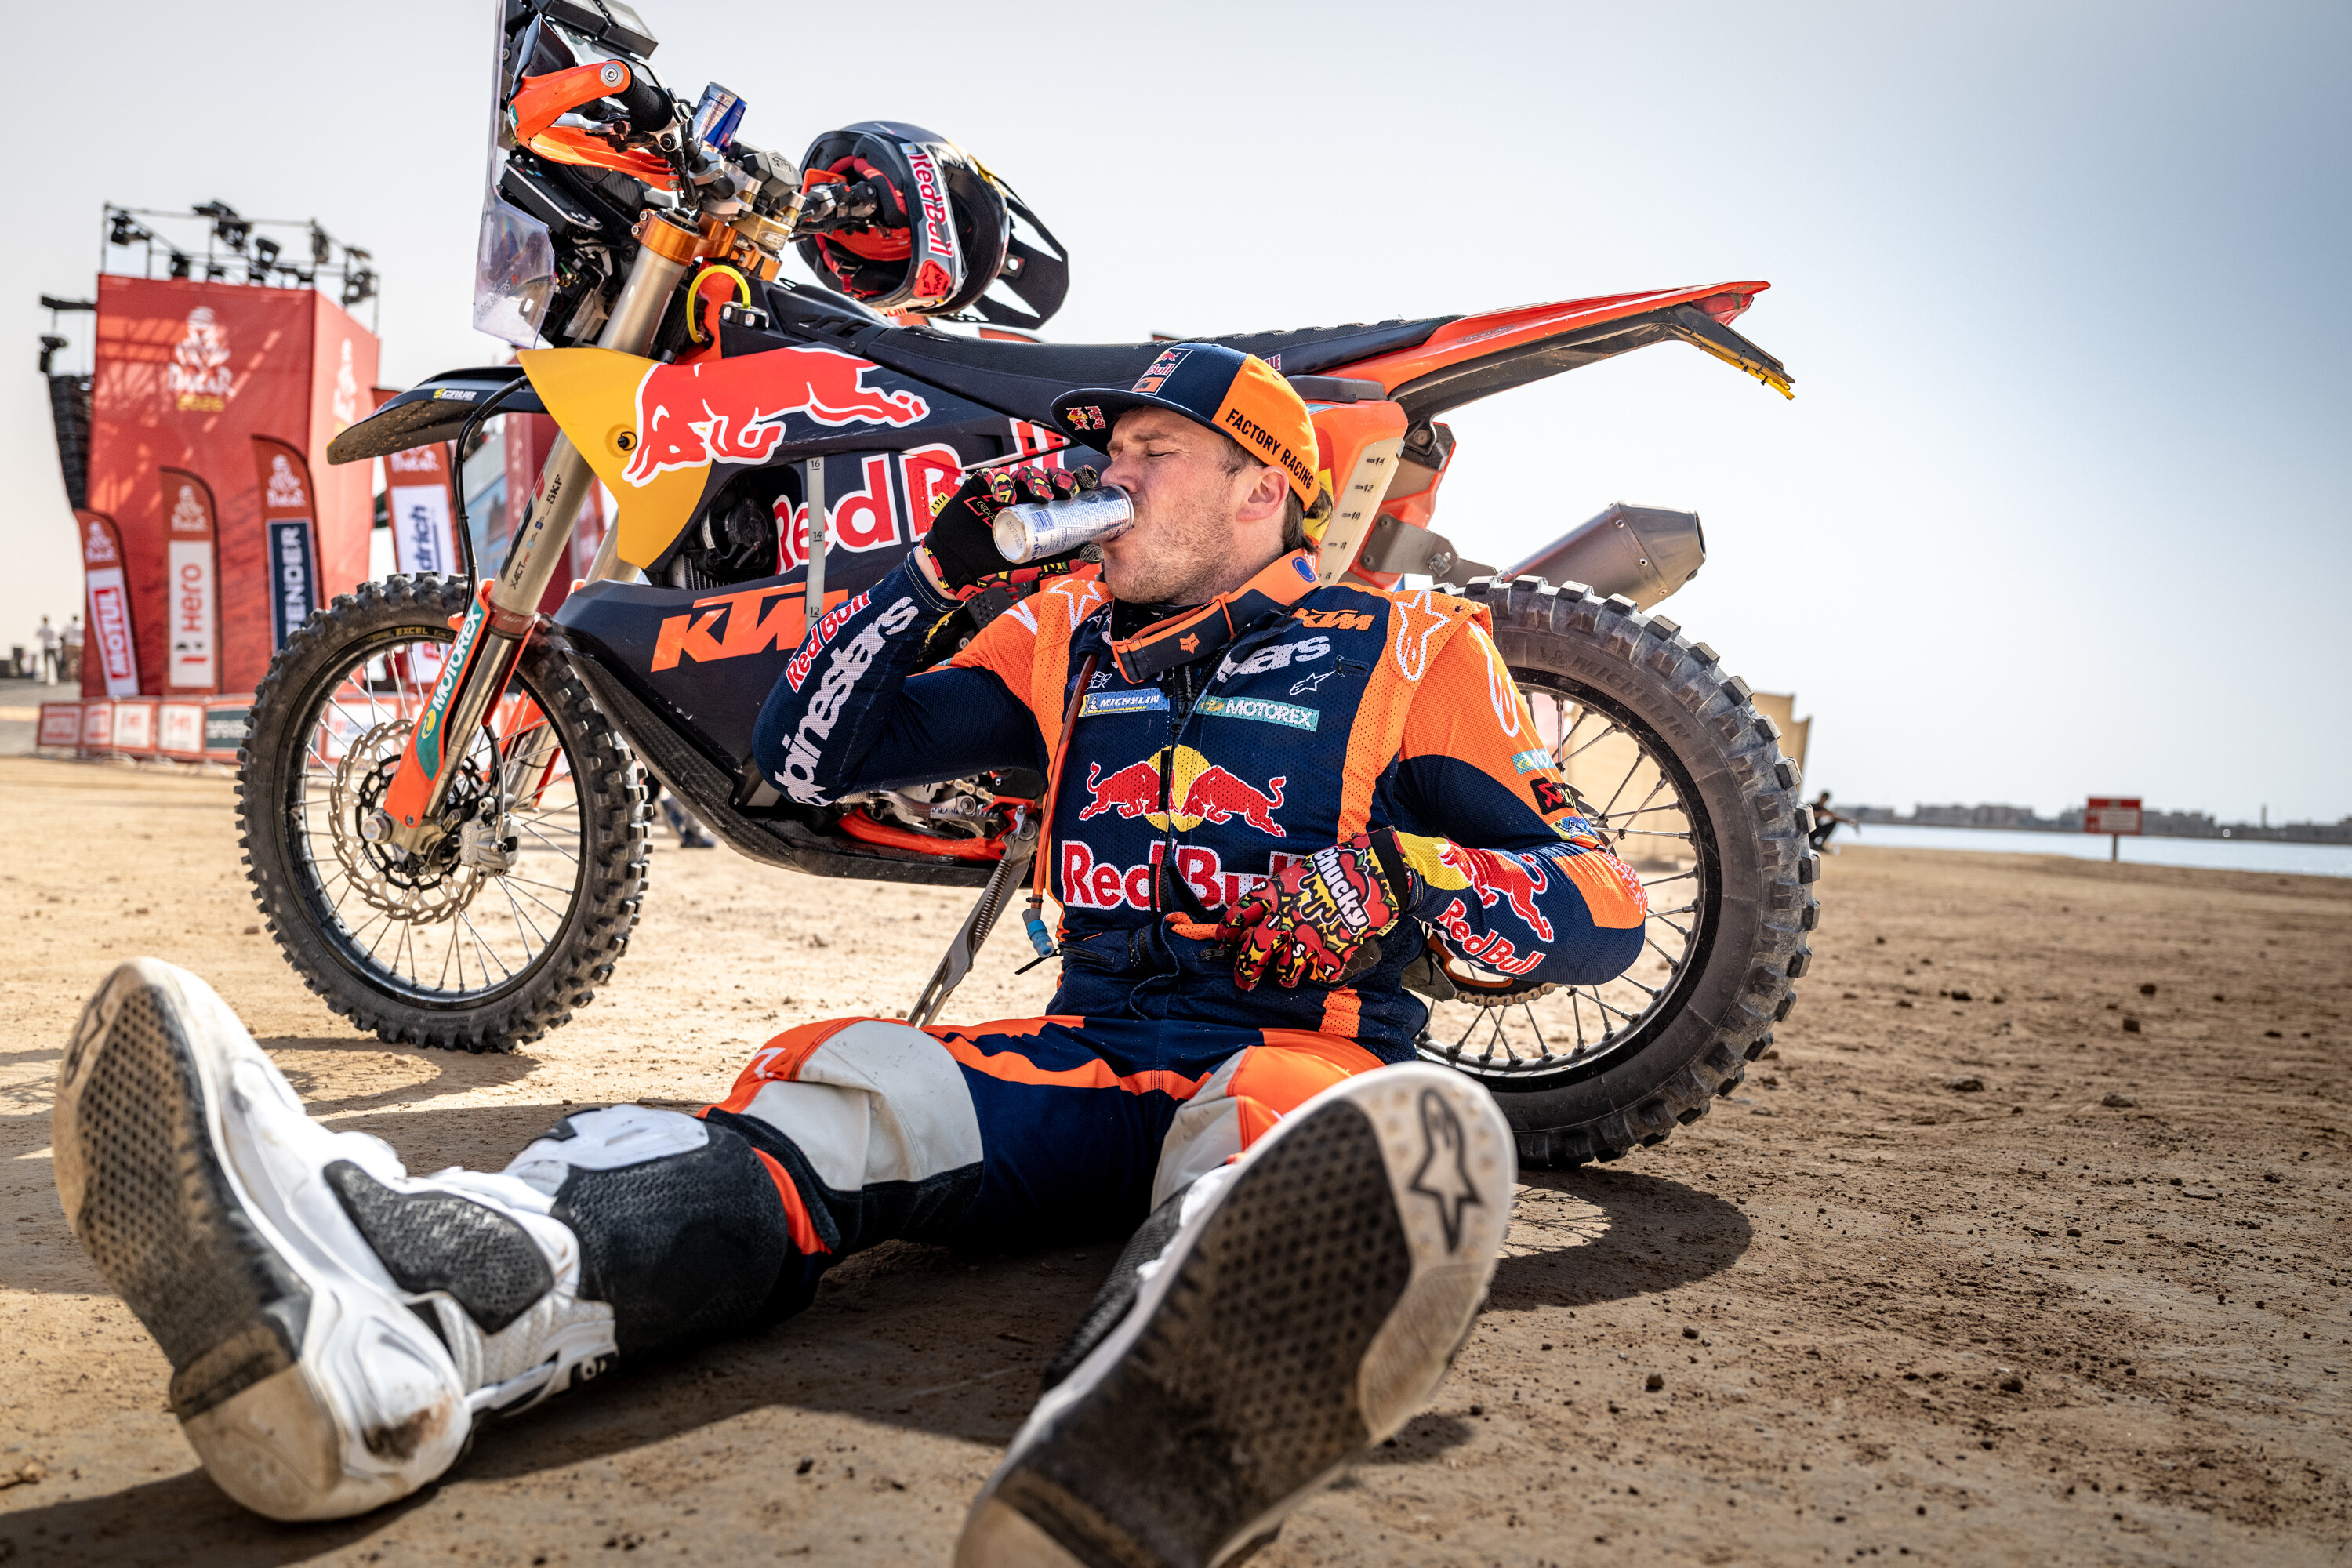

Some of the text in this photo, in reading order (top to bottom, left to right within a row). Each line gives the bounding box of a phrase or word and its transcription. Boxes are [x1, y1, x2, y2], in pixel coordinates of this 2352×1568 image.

[1089, 416, 1106, 429] Red
[1225, 408, 1314, 490] FACTORY RACING
[1375, 457, 1385, 466] 14
[811, 459, 821, 469] 16
[546, 474, 562, 505] SKF
[931, 494, 946, 511] FIST
[1363, 484, 1374, 492] 12
[411, 504, 429, 571] drich
[813, 531, 822, 540] 14
[281, 527, 306, 637] FENDER
[510, 561, 527, 589] XACT
[181, 563, 202, 633] Hero
[810, 606, 820, 615] 12
[98, 589, 129, 675] MOTUL
[396, 626, 429, 636] EXCEL
[651, 581, 848, 673] KTM
[1292, 608, 1376, 631] KTM
[786, 590, 871, 694] Red Bull
[431, 608, 481, 711] MOTOREX
[1099, 695, 1160, 707] MICHELIN
[1225, 699, 1314, 728] MOTOREX
[1571, 655, 1693, 744] MICHELIN
[1062, 840, 1168, 912] Red
[1379, 920, 1395, 934] FIST
[1435, 897, 1546, 975] Red Bull
